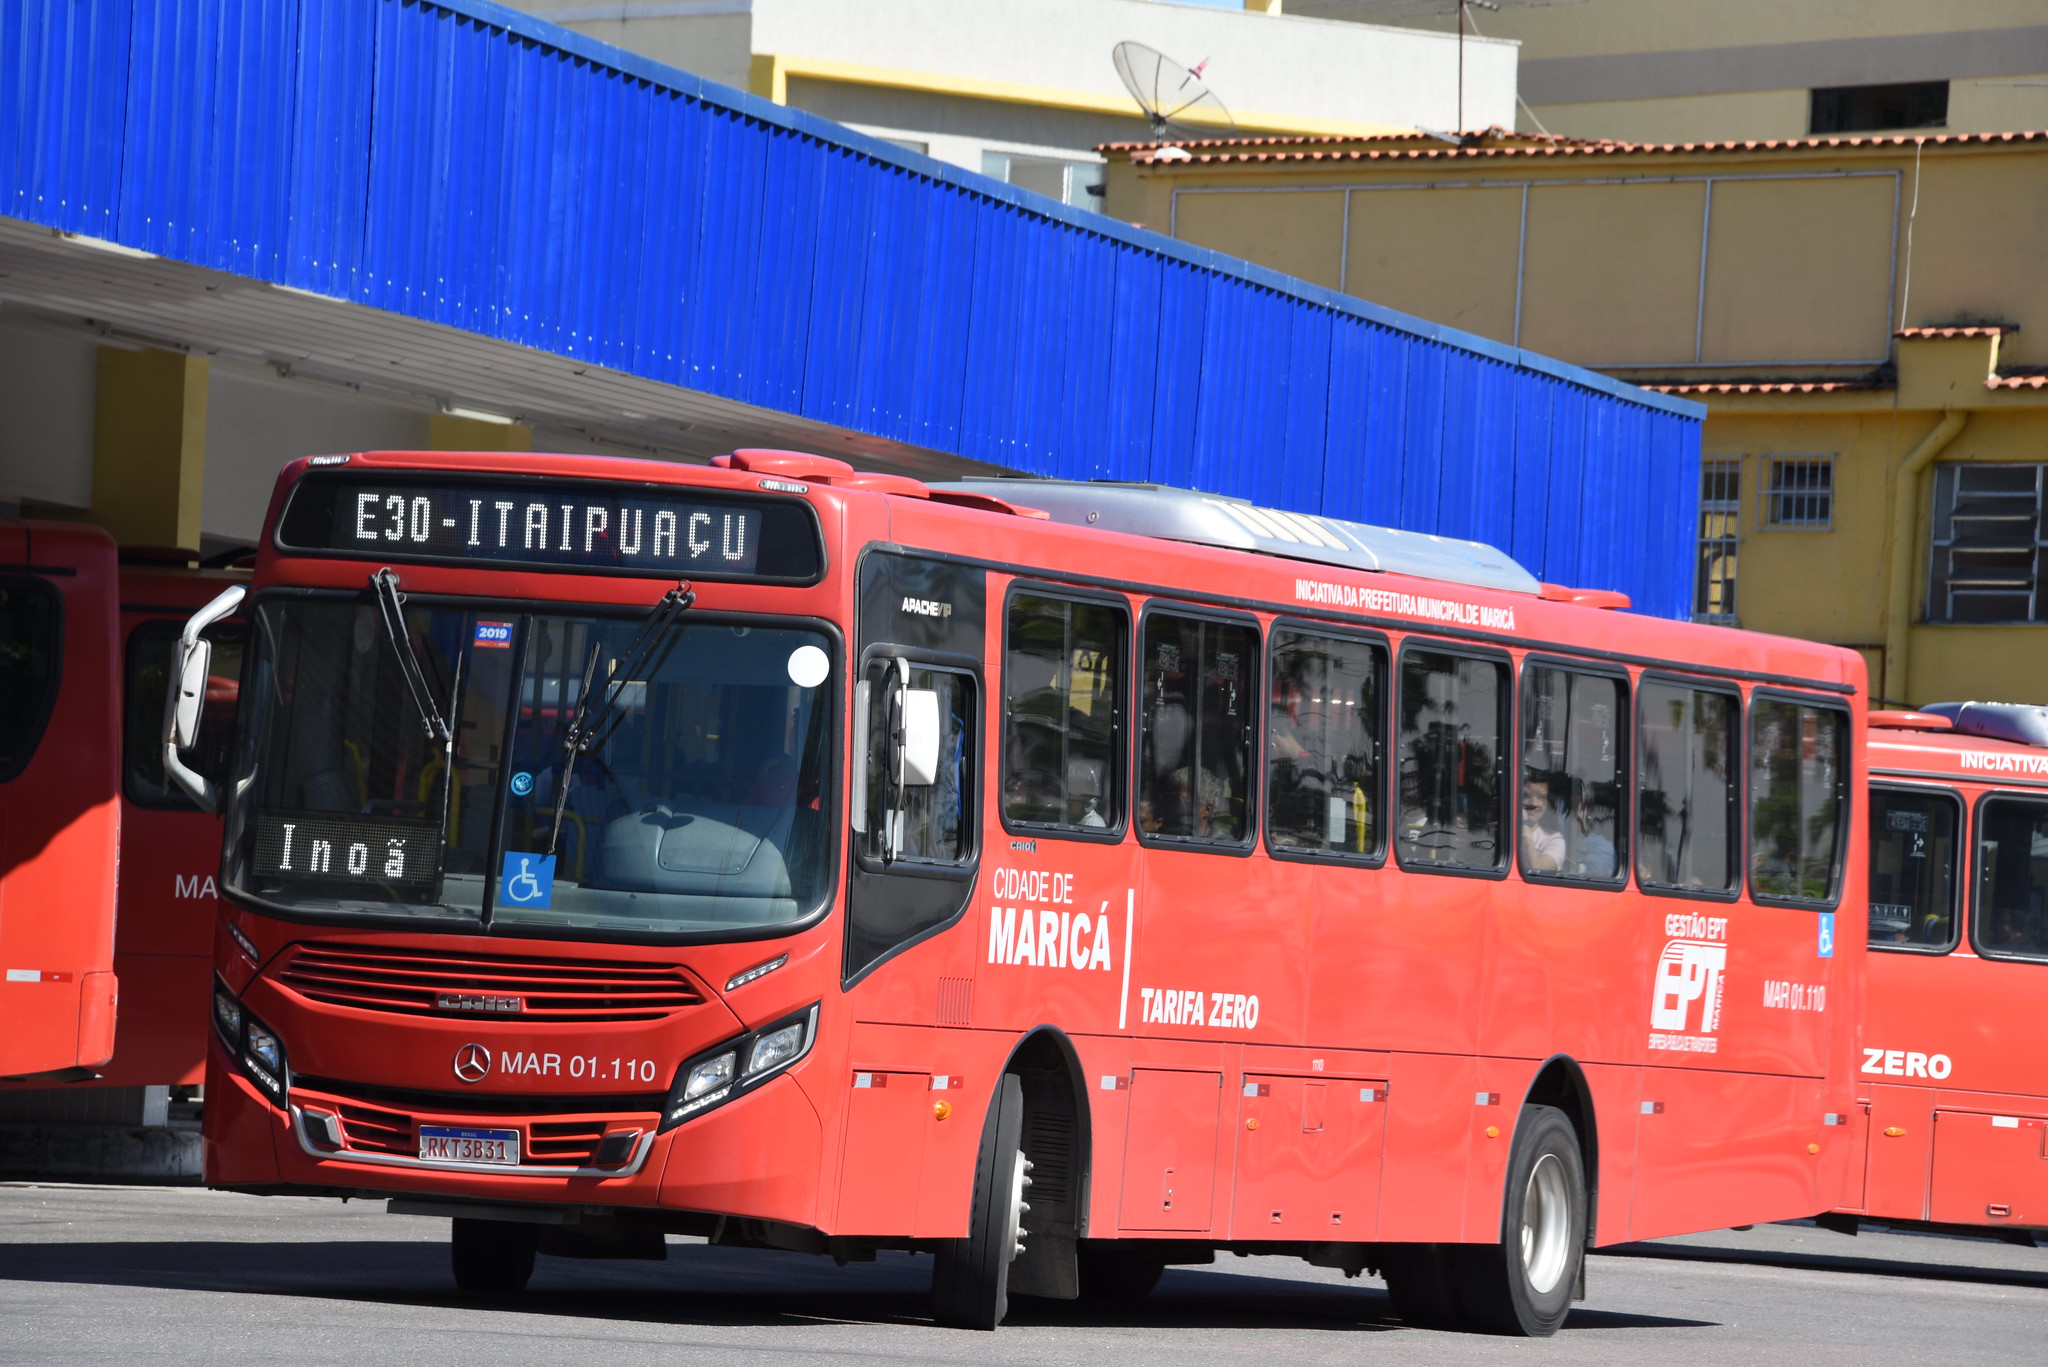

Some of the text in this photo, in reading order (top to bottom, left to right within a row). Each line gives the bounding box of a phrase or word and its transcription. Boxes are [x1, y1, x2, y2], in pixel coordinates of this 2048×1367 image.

[356, 493, 430, 543] E30
[467, 499, 747, 562] ITAIPUAÇU
[901, 597, 940, 617] APACHE
[1295, 578, 1515, 630] INICIATIVA DA PREFEITURA MUNICIPAL DE MARICÁ
[478, 627, 508, 639] 2019
[1961, 752, 2048, 774] INICIATIVA
[279, 824, 406, 878] Inoã
[994, 867, 1074, 904] CIDADE DE
[987, 901, 1111, 971] MARICÁ
[1665, 912, 1728, 940] GESTÃO EPT
[1141, 987, 1259, 1030] TARIFA ZERO
[1763, 980, 1826, 1012] MAR 01.110
[500, 1051, 656, 1082] MAR 01.110
[1861, 1048, 1952, 1080] ZERO
[428, 1137, 507, 1160] RKT3B31
